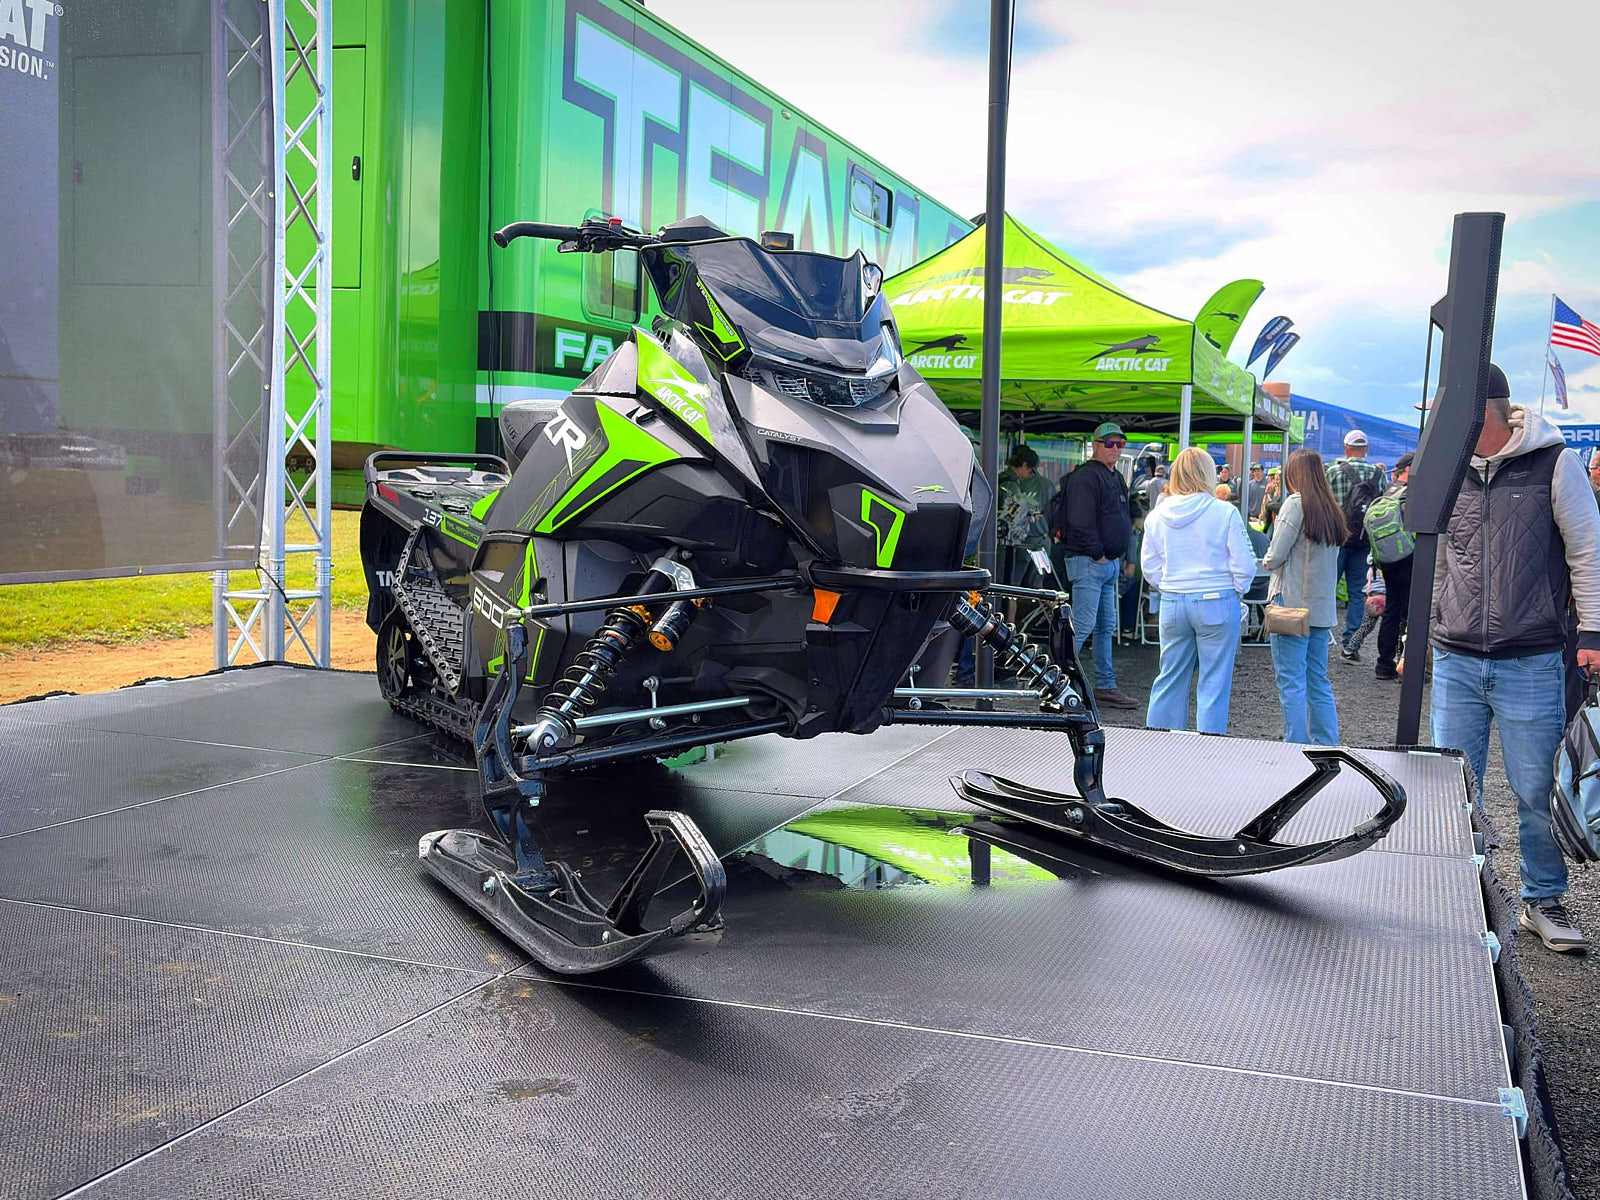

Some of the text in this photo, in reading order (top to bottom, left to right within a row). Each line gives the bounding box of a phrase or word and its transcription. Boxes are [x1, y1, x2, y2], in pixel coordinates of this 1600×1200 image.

[564, 3, 920, 280] TEAM
[1002, 288, 1068, 305] CAT
[910, 355, 977, 369] ARCTIC CAT
[1095, 357, 1170, 372] ARCTIC CAT
[654, 385, 704, 424] ARCTIC CAT
[543, 407, 587, 477] ZR
[757, 428, 802, 443] CATALYST
[422, 508, 443, 528] 137
[473, 586, 504, 629] 600
